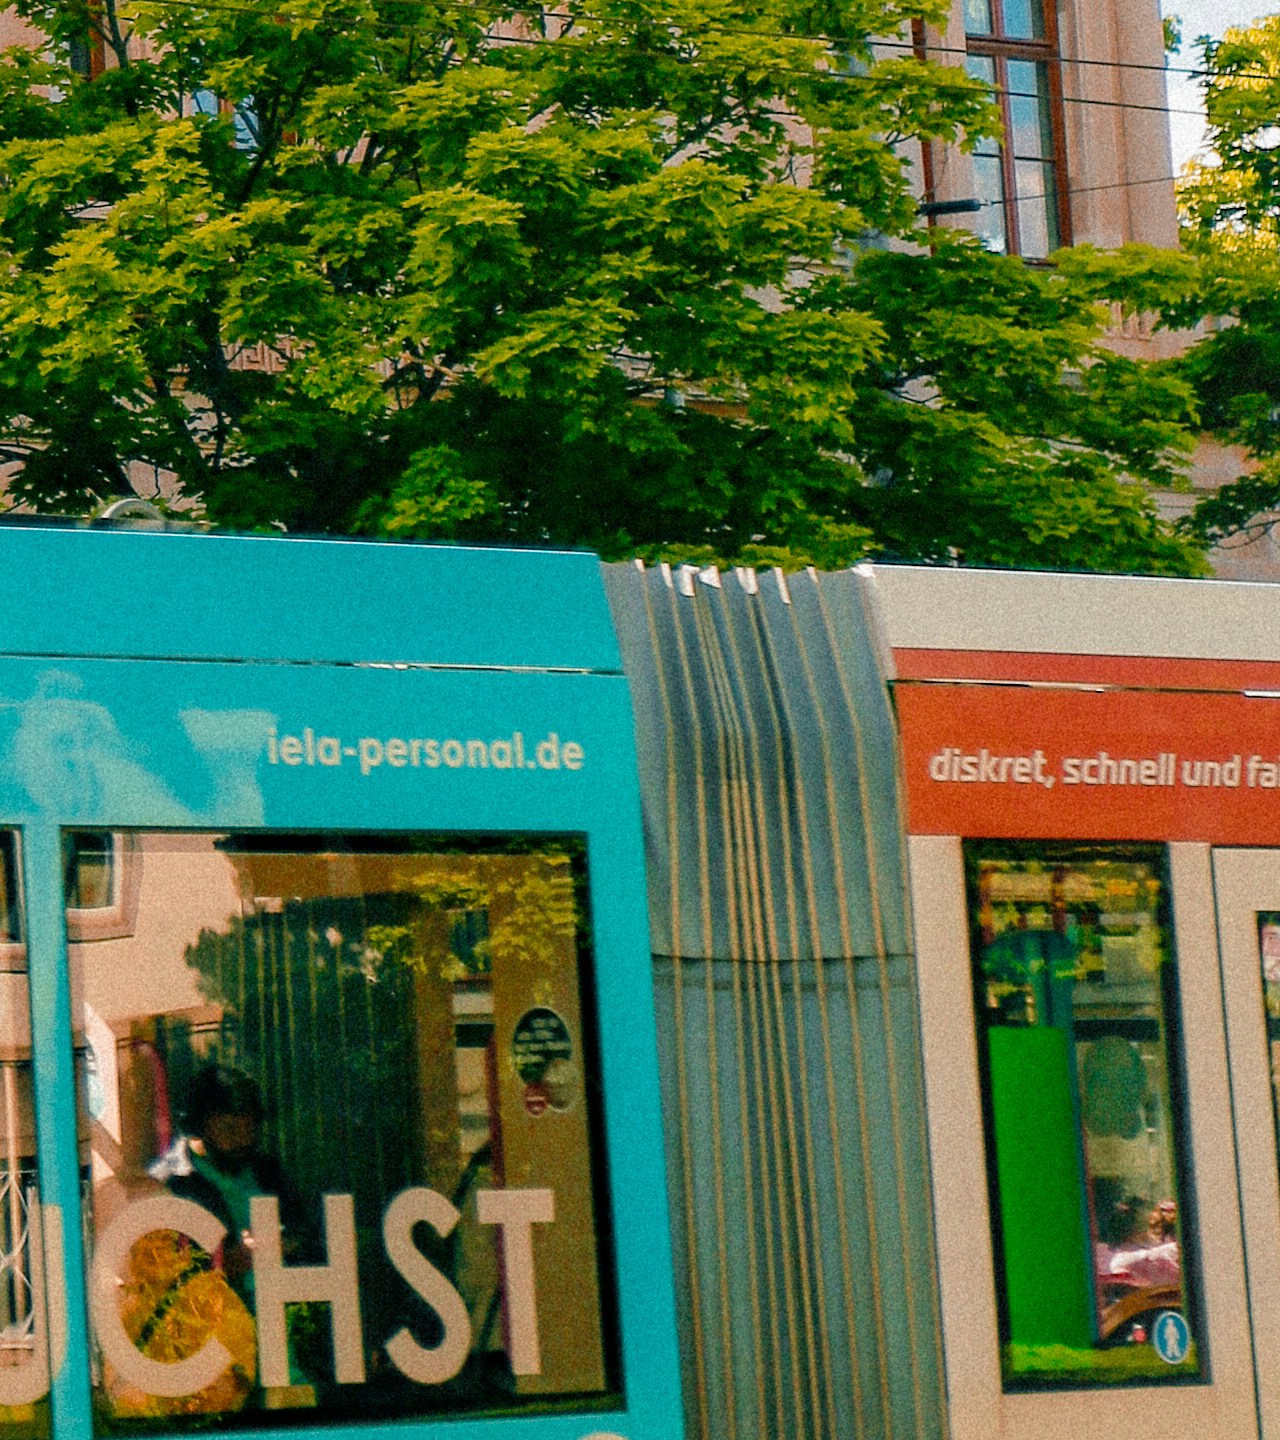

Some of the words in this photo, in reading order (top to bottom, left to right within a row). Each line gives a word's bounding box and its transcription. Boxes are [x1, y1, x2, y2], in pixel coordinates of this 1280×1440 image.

[267, 726, 584, 775] iela-personal.de
[929, 748, 1055, 788] diskret,
[1062, 752, 1176, 785] schnell
[1182, 754, 1241, 787] und
[1247, 754, 1280, 788] fa
